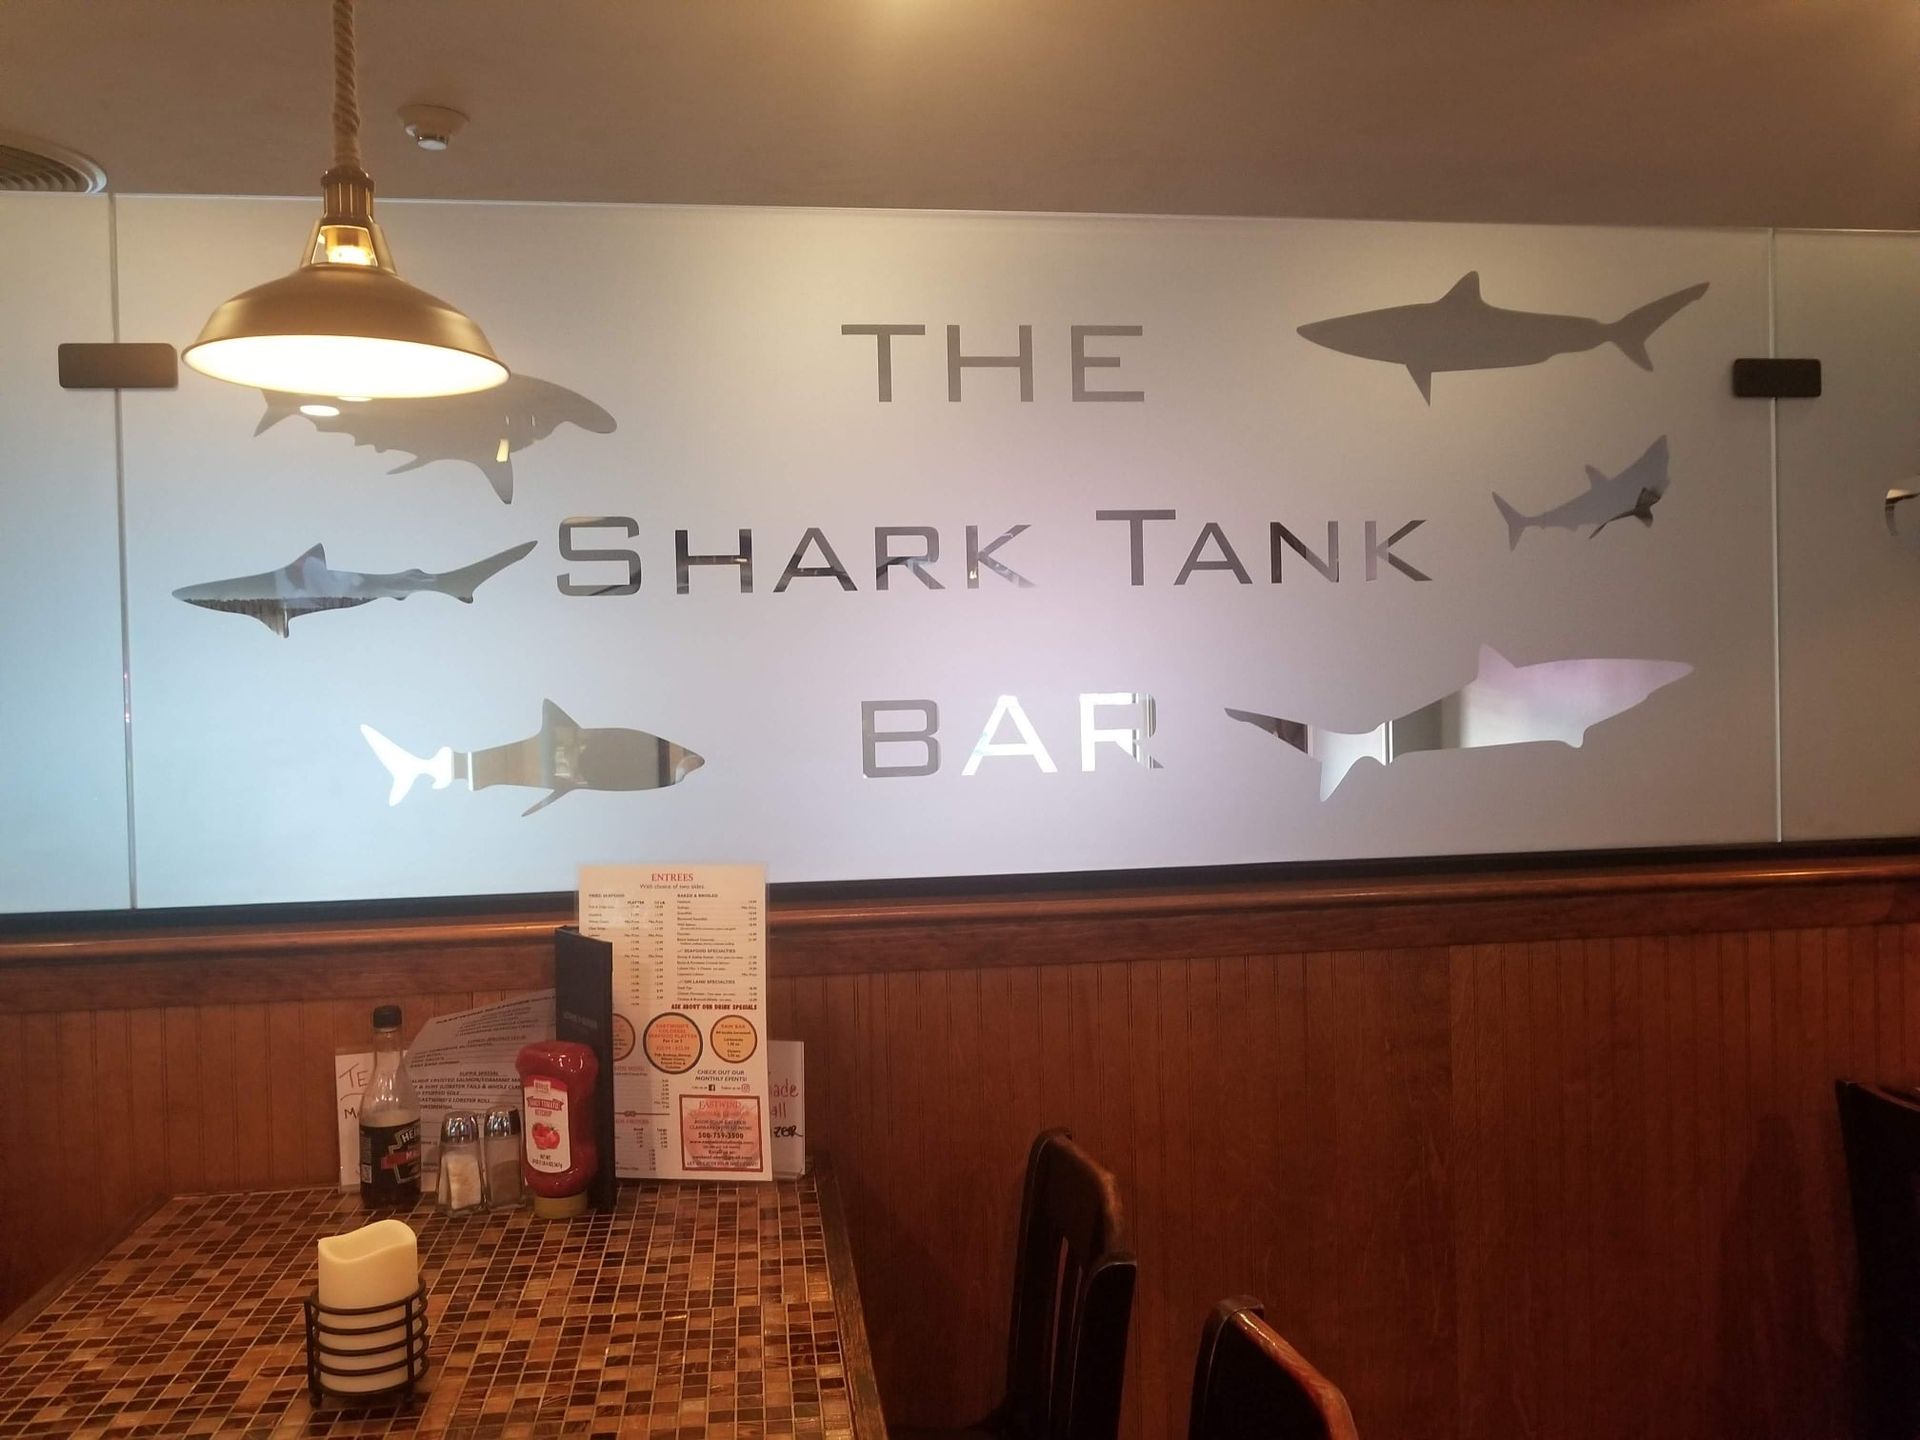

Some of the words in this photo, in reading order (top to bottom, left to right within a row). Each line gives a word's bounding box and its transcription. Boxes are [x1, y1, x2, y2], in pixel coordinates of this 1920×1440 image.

[841, 324, 1146, 403] THE
[557, 515, 1037, 597] SHARK
[1095, 509, 1433, 586] TANK
[860, 692, 1164, 780] BAR
[651, 873, 694, 882] ENTREES
[771, 1077, 799, 1098] ade
